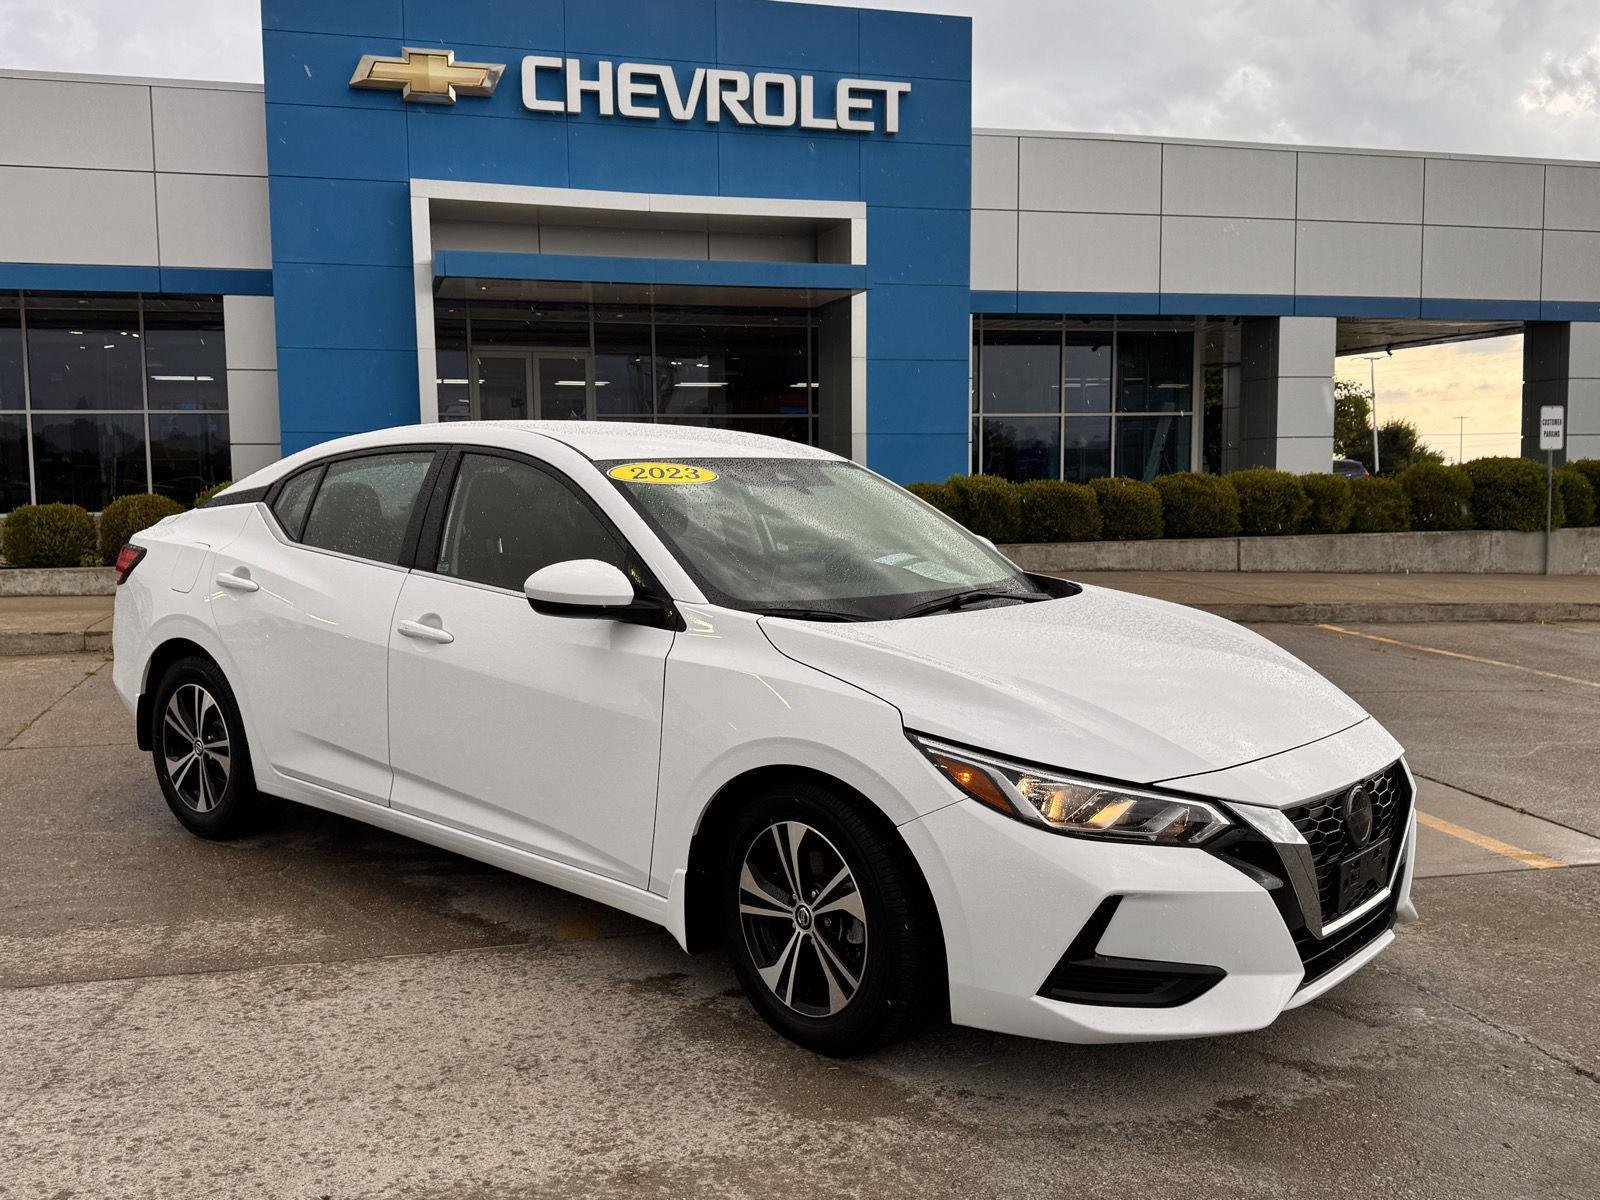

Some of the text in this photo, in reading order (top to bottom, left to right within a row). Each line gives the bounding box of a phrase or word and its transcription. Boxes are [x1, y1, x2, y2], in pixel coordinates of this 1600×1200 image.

[521, 55, 912, 134] CHEVROLET
[1543, 430, 1560, 438] PARKING
[630, 467, 700, 480] 2023
